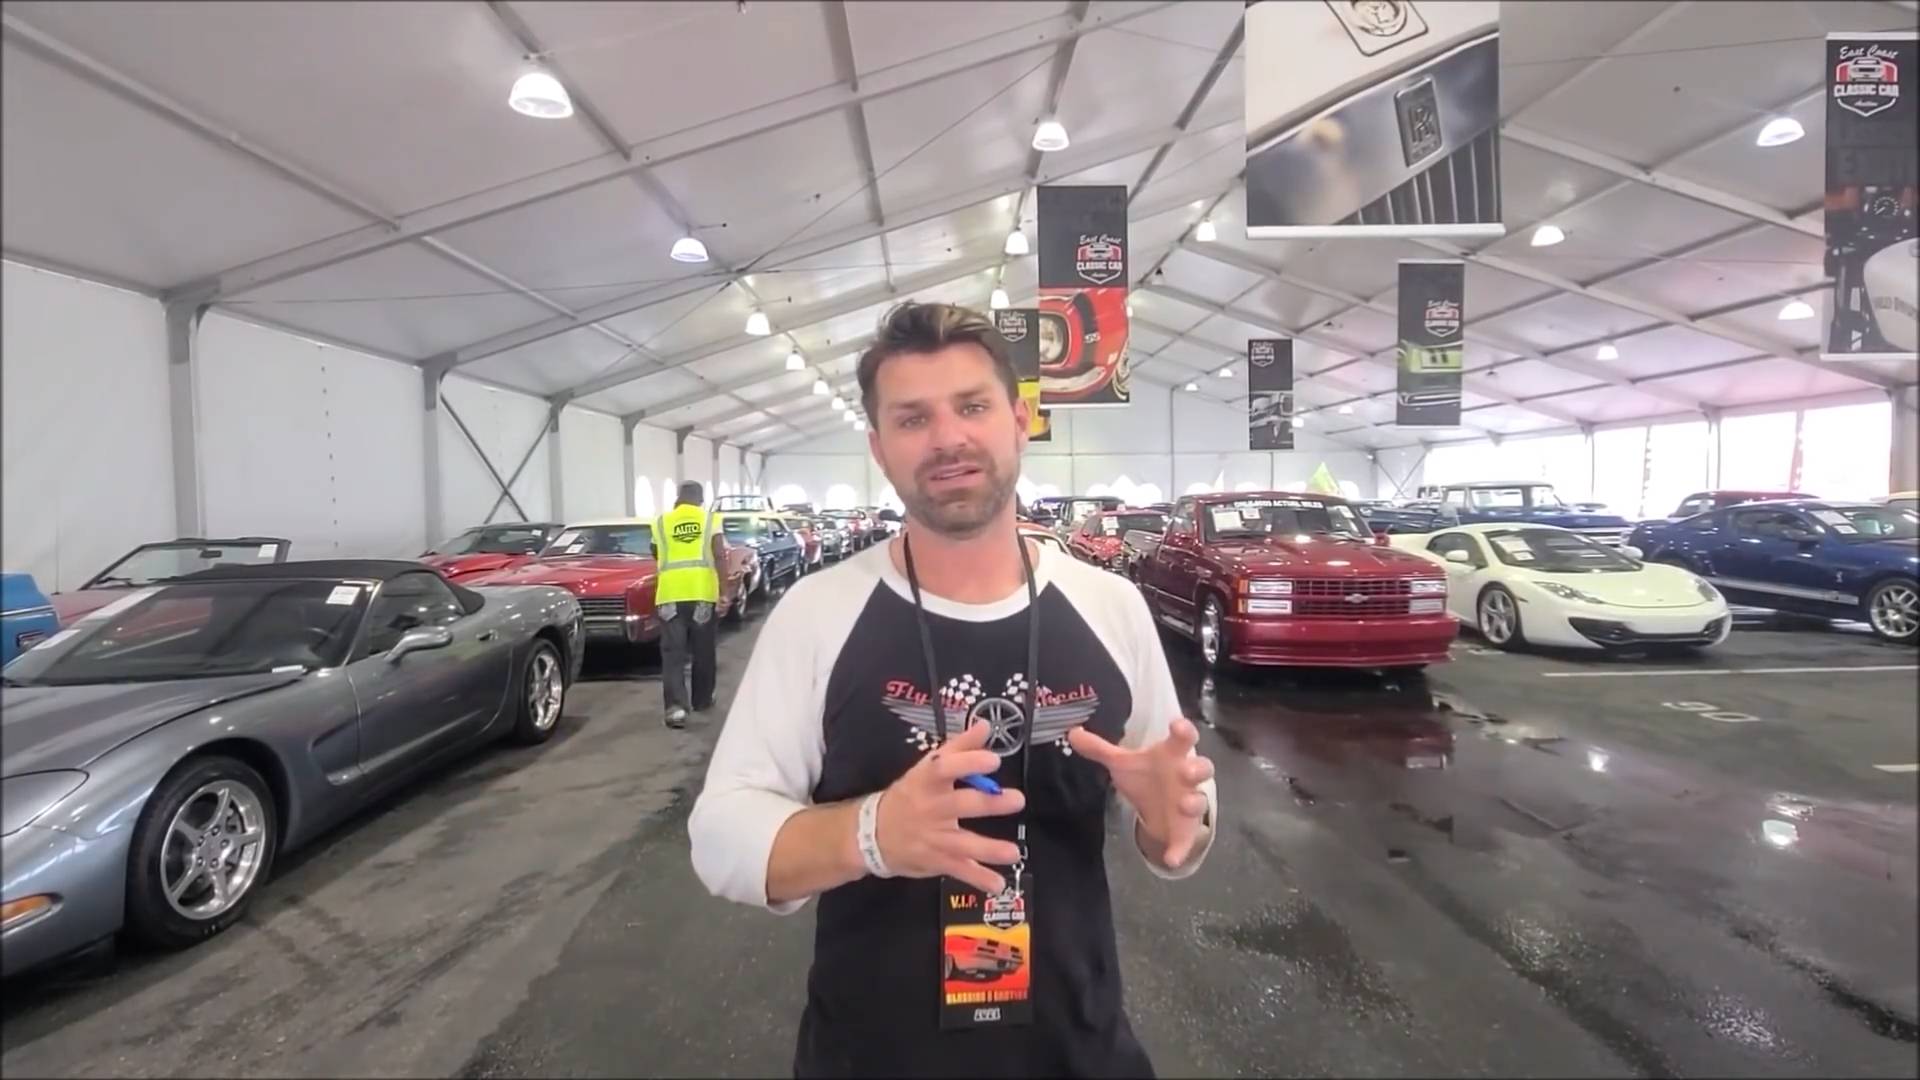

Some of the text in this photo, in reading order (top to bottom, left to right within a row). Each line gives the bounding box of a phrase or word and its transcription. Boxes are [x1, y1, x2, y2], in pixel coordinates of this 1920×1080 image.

[1839, 44, 1898, 60] East Coast
[1834, 84, 1900, 97] CLASSIC CAR
[1076, 262, 1123, 271] CLASSIC CAR
[675, 524, 698, 534] AUTO
[950, 894, 978, 909] V.I.P.
